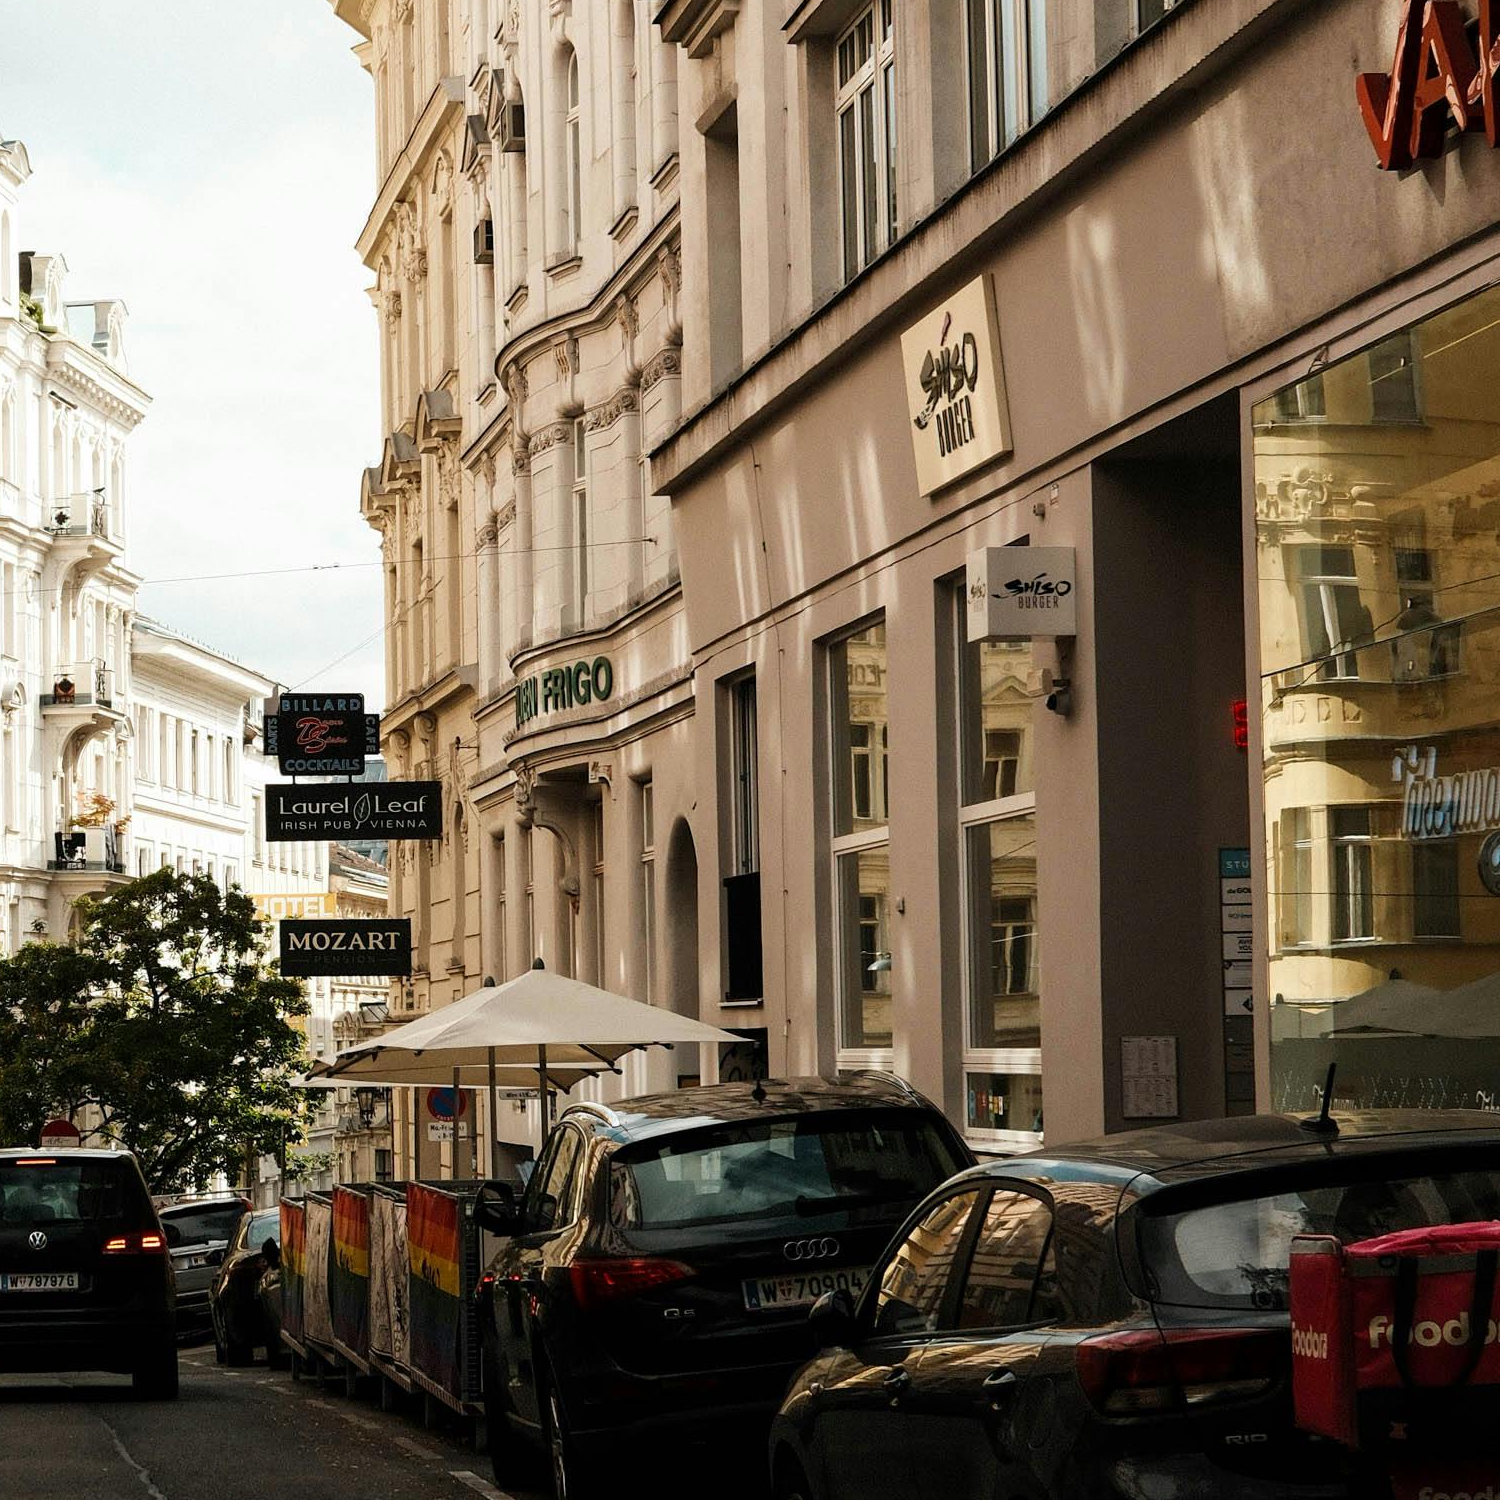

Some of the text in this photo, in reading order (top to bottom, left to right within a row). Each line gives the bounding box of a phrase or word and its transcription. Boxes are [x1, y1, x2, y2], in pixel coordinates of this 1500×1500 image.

[936, 394, 975, 458] BURGER
[1018, 595, 1059, 609] BURGER
[542, 656, 613, 715] FRIGO
[281, 698, 361, 712] BILLARD
[267, 717, 278, 754] DARTS
[285, 758, 360, 772] COCKTAILS
[279, 795, 428, 815] Laurel Leaf
[280, 819, 428, 830] IRISH PUB VIENNA
[256, 896, 333, 917] HOTEL
[288, 932, 400, 951] MOZART
[314, 955, 376, 963] PENSION
[1224, 1432, 1269, 1445] RIO
